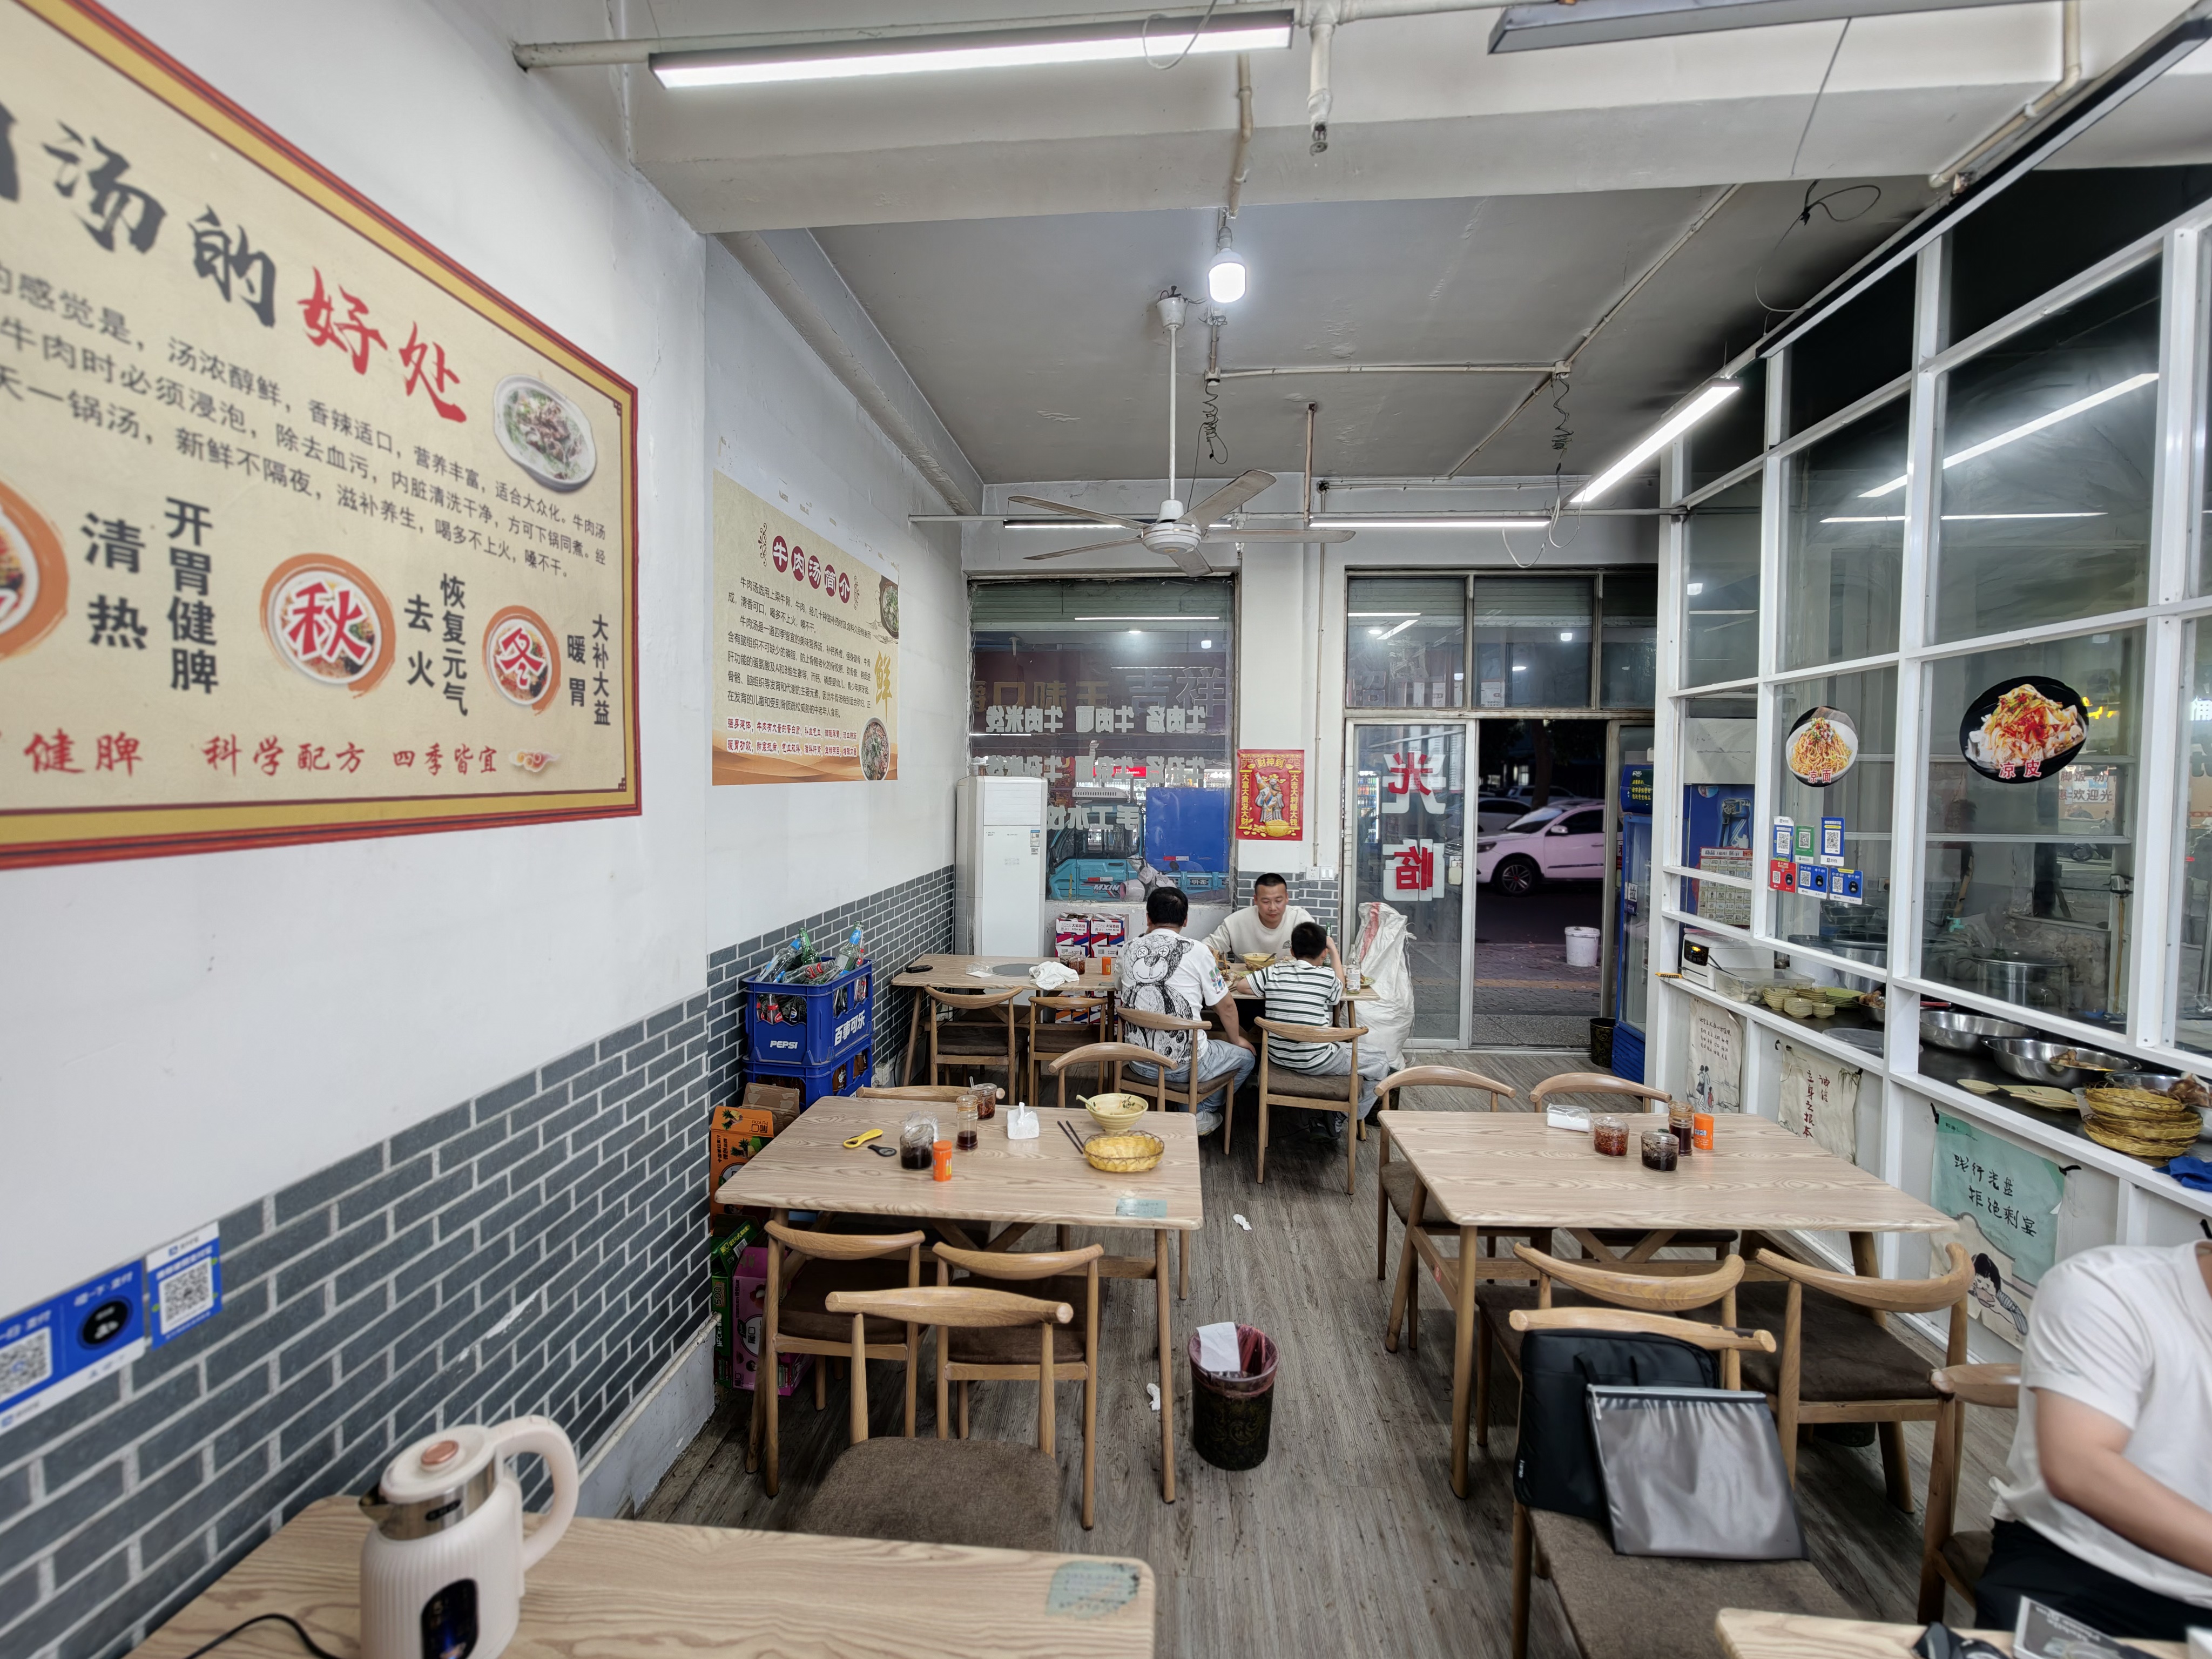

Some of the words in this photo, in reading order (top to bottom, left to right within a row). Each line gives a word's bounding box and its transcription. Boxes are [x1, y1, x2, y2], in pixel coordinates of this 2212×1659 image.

[80, 512, 147, 650] 清热
[164, 496, 219, 694] 开胃健脾
[773, 540, 850, 602] 牛肉汤简介
[288, 581, 370, 660] 秋
[404, 594, 435, 688] 去火
[440, 573, 468, 716] 恢复元气
[496, 627, 544, 687] 冬
[567, 635, 586, 707] 暖胃
[592, 614, 610, 726] 大补大益
[23, 728, 145, 777] 健脾
[202, 733, 366, 777] 科学配方
[392, 742, 498, 776] 四季皆宜
[1808, 768, 1832, 784] 凉面
[1998, 759, 2042, 779] 凉皮
[770, 1040, 798, 1049] PEPSI
[834, 1009, 865, 1047] 百事可乐
[1953, 1154, 2013, 1197] 践行光盘
[713, 1286, 722, 1305] 500
